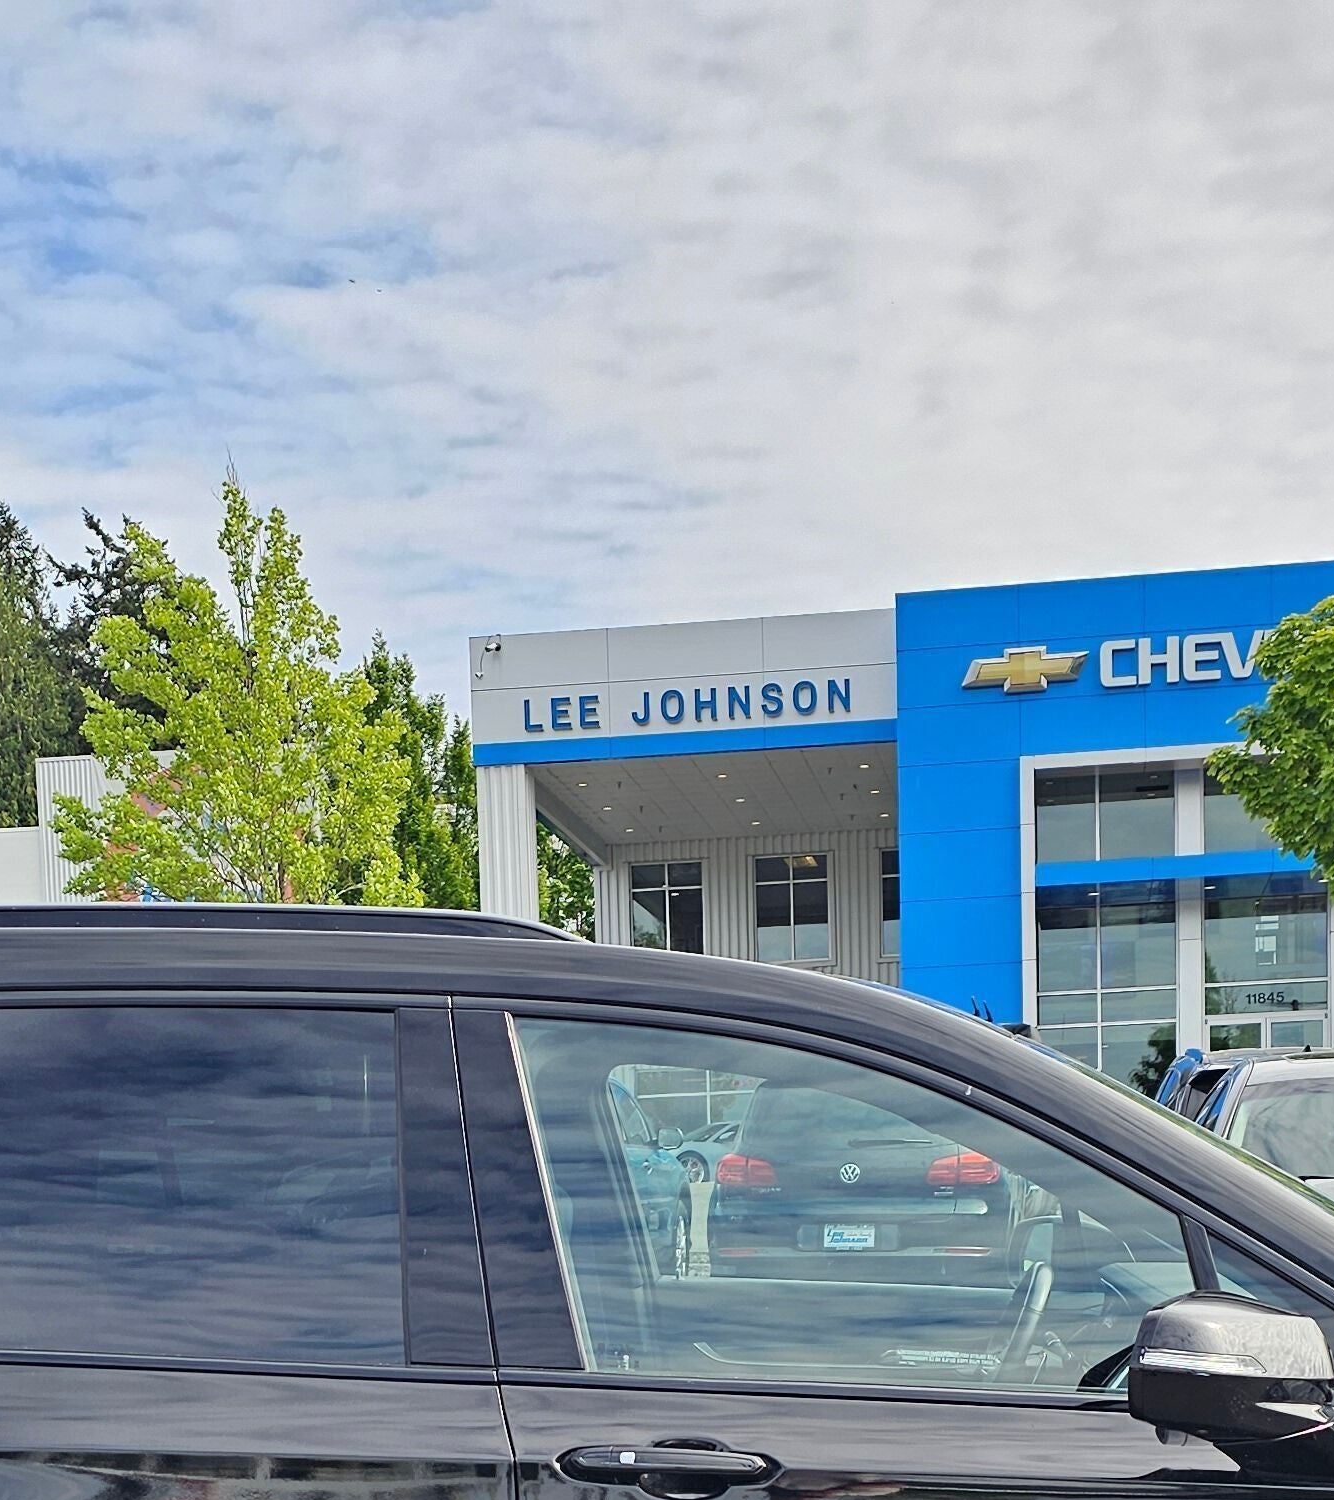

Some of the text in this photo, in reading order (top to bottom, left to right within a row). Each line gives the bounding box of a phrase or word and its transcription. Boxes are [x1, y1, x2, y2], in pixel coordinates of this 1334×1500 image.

[523, 678, 852, 733] LEE JOHNSON
[1245, 991, 1285, 1005] 11845
